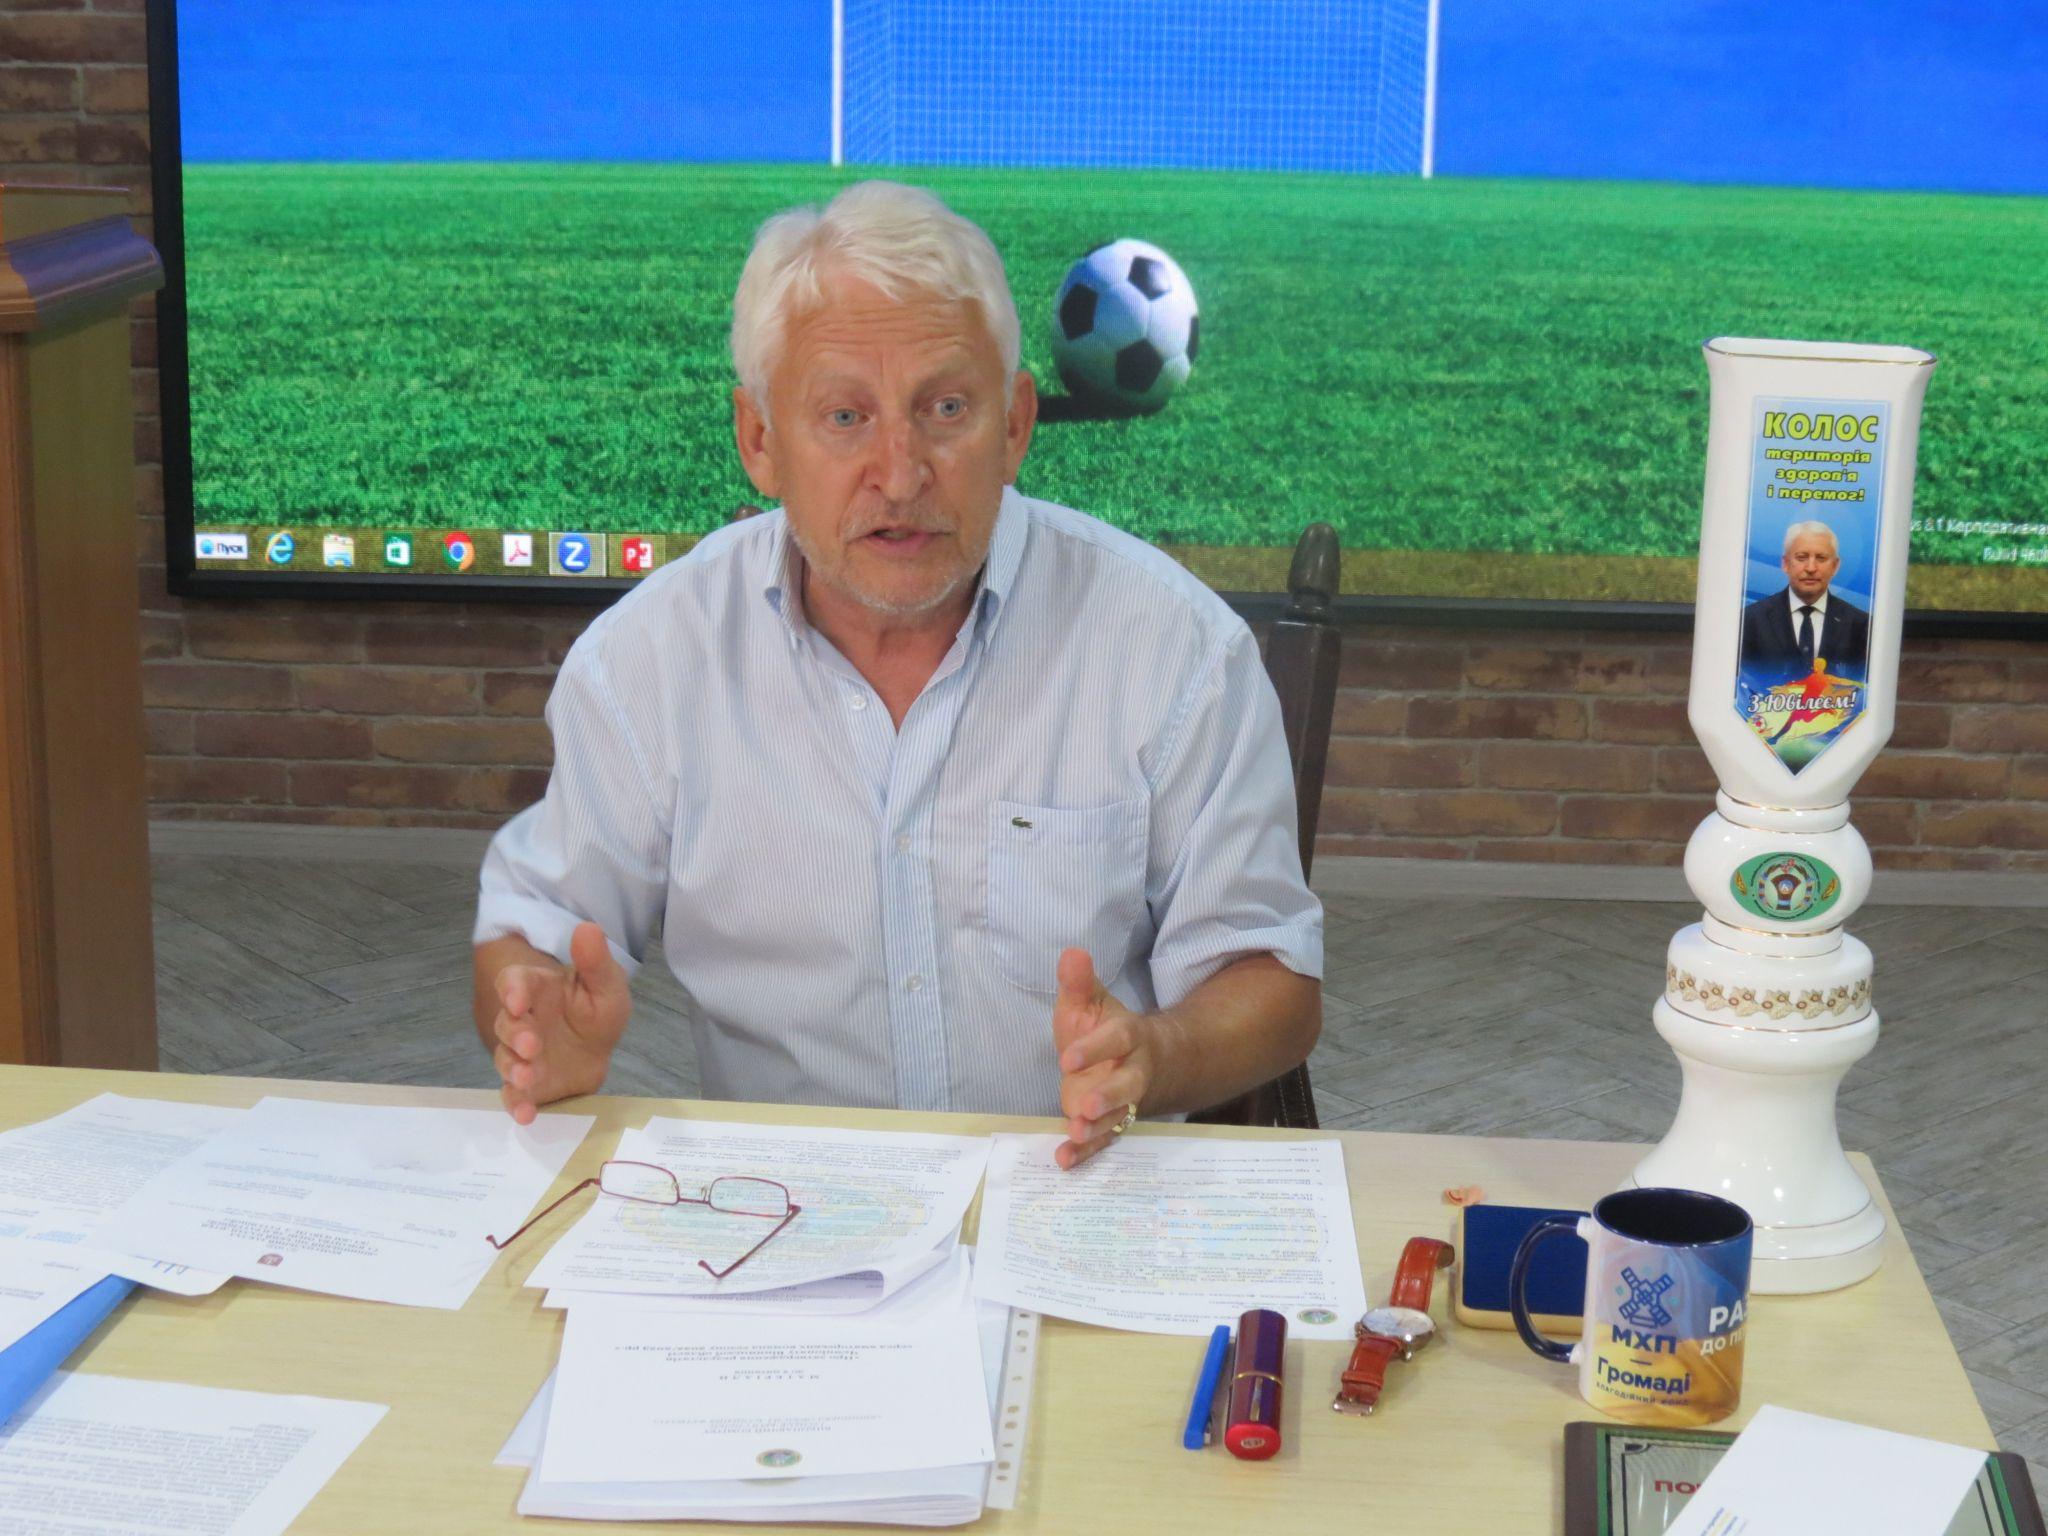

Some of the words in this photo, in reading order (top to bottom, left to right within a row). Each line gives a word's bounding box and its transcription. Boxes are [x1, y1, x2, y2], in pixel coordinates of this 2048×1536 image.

[1763, 411, 1879, 443] КОЛОС
[1765, 448, 1872, 466] територія
[1775, 468, 1859, 484] здоров'я
[1767, 484, 1774, 498] і
[1778, 487, 1866, 503] перемог!
[216, 542, 244, 555] Пуск
[1748, 694, 1760, 712] З
[1764, 690, 1858, 712] Ювілеєм!
[1709, 1299, 1748, 1333] РА
[1612, 1324, 1678, 1355] МХП
[1700, 1336, 1727, 1356] ДО
[1597, 1356, 1691, 1395] Громаді
[1654, 1480, 1702, 1495] ПО
